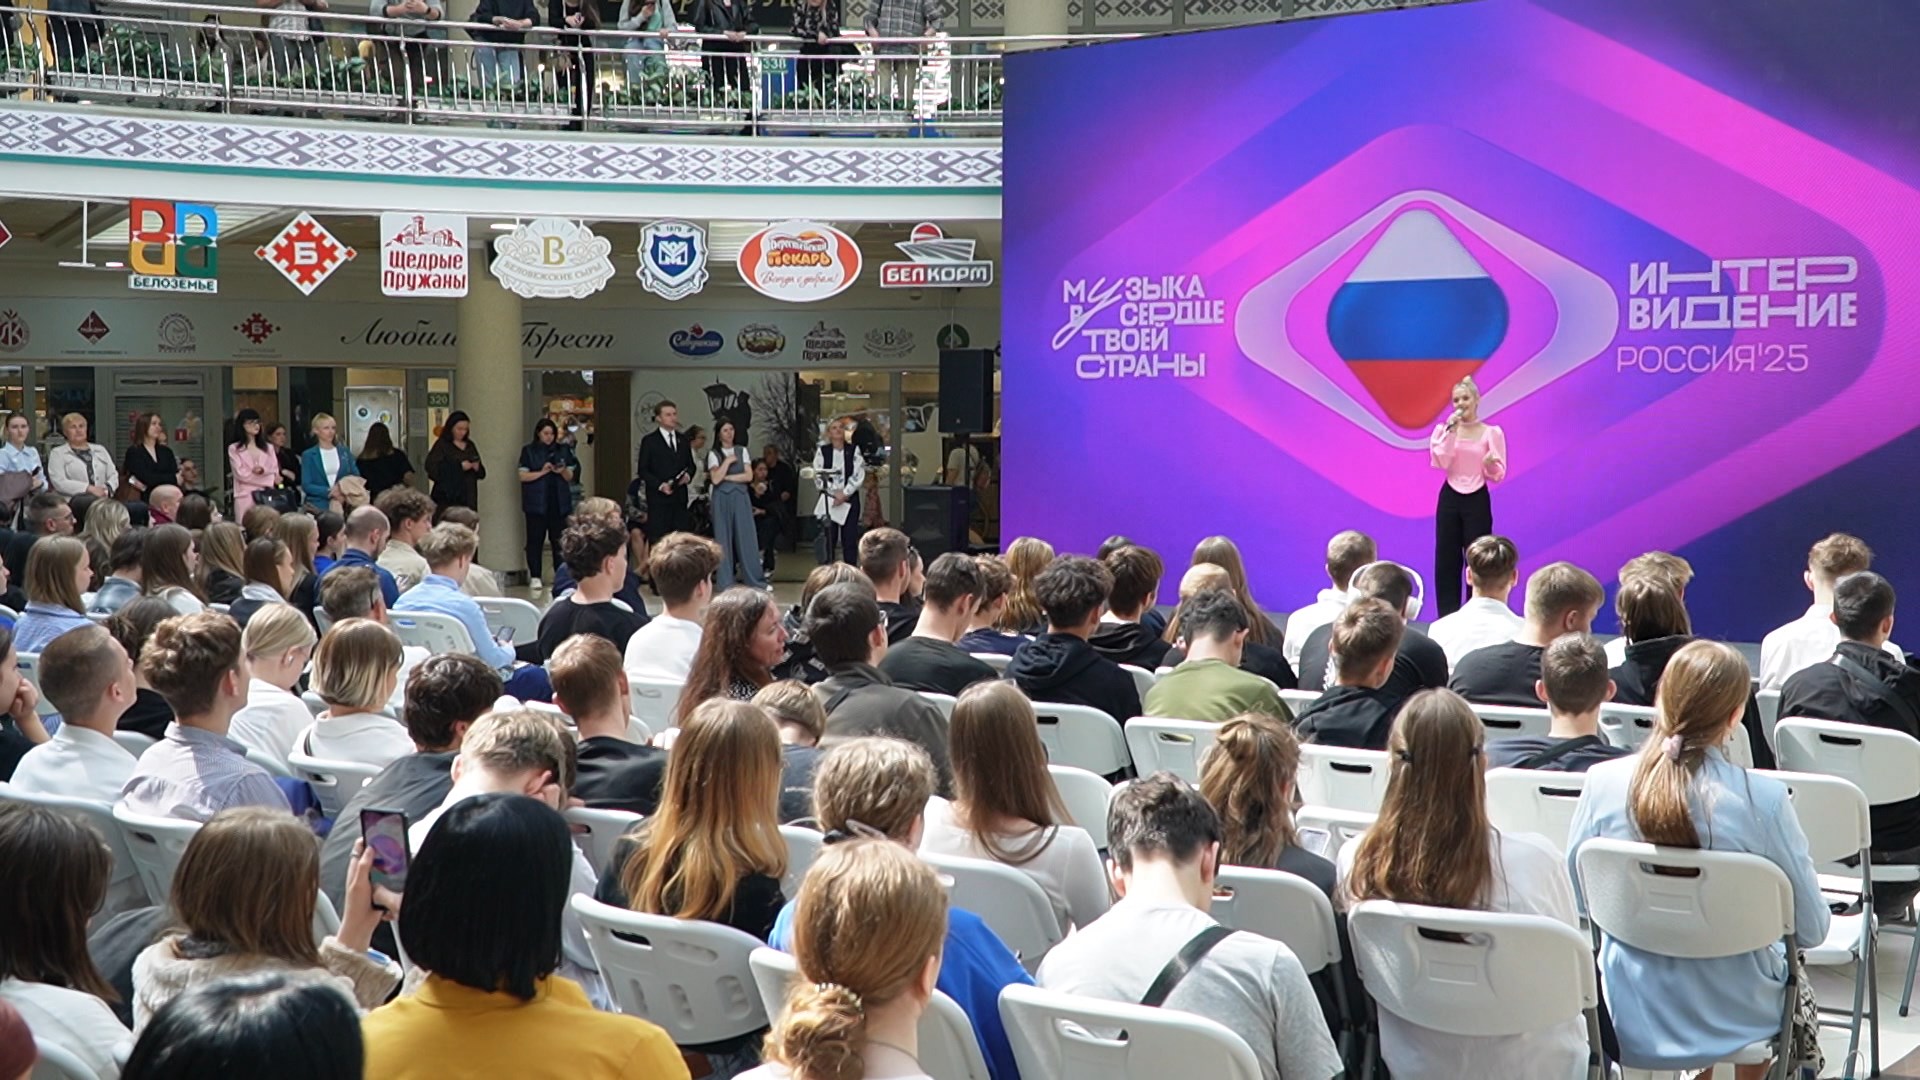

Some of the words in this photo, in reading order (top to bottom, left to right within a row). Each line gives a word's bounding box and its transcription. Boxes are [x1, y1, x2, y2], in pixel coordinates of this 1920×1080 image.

[293, 241, 319, 265] Б
[388, 251, 463, 271] Щедрые
[133, 276, 215, 291] БЕЛОЗЕМЬЕ
[383, 270, 466, 291] Пружаны
[886, 265, 988, 282] БЕЛКОРМ
[1629, 255, 1858, 295] ИНТЕР
[1119, 300, 1225, 326] СЕРДЦЕ
[1628, 292, 1858, 330] ВИДЕНИЕ
[340, 318, 457, 347] Любим
[522, 321, 616, 359] Брест
[1082, 322, 1169, 351] ТВОЕЙ
[1075, 353, 1206, 379] СТРАНЫ
[1616, 343, 1809, 374] РОССИЯ'25
